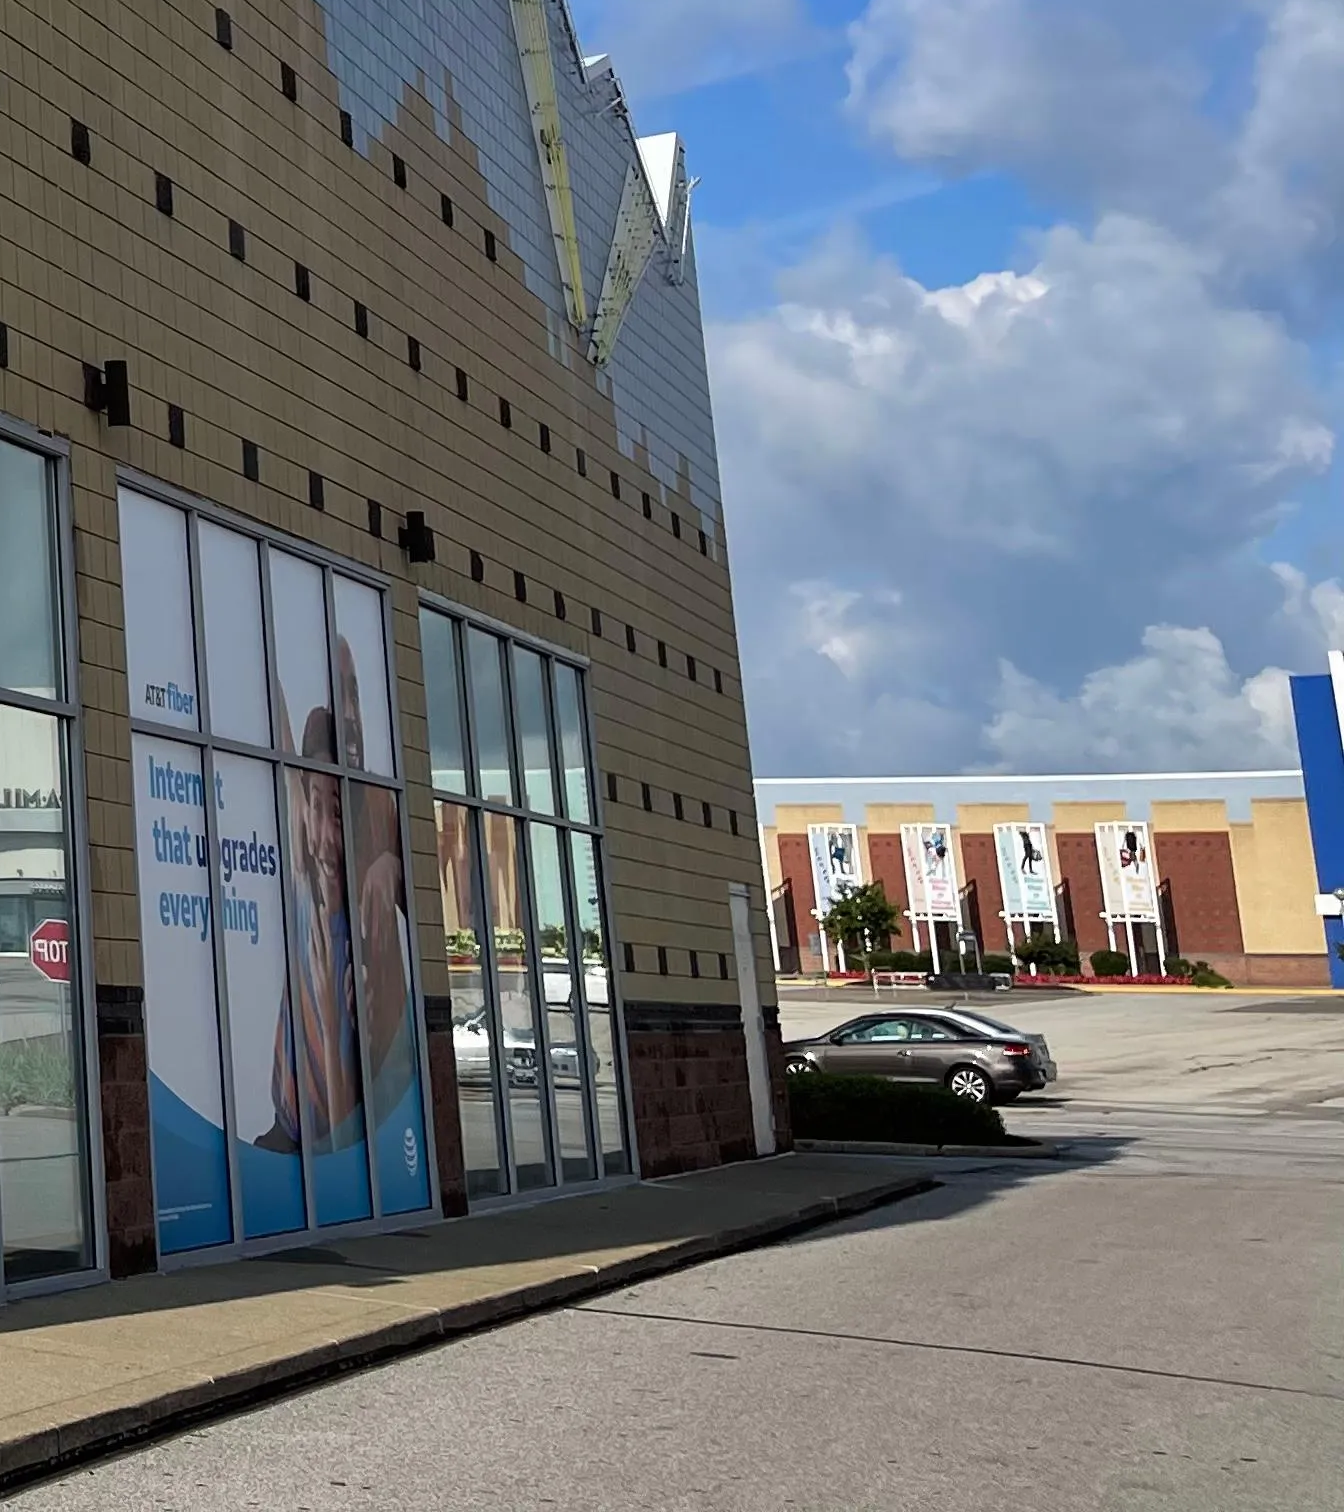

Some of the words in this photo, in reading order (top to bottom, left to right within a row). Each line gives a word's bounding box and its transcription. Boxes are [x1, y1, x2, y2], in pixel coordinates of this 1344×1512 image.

[145, 684, 166, 707] AT&T
[166, 682, 194, 716] fiber
[148, 755, 225, 810] Internt
[153, 816, 192, 866] that
[195, 831, 277, 882] ugrades
[159, 886, 259, 945] everyhing
